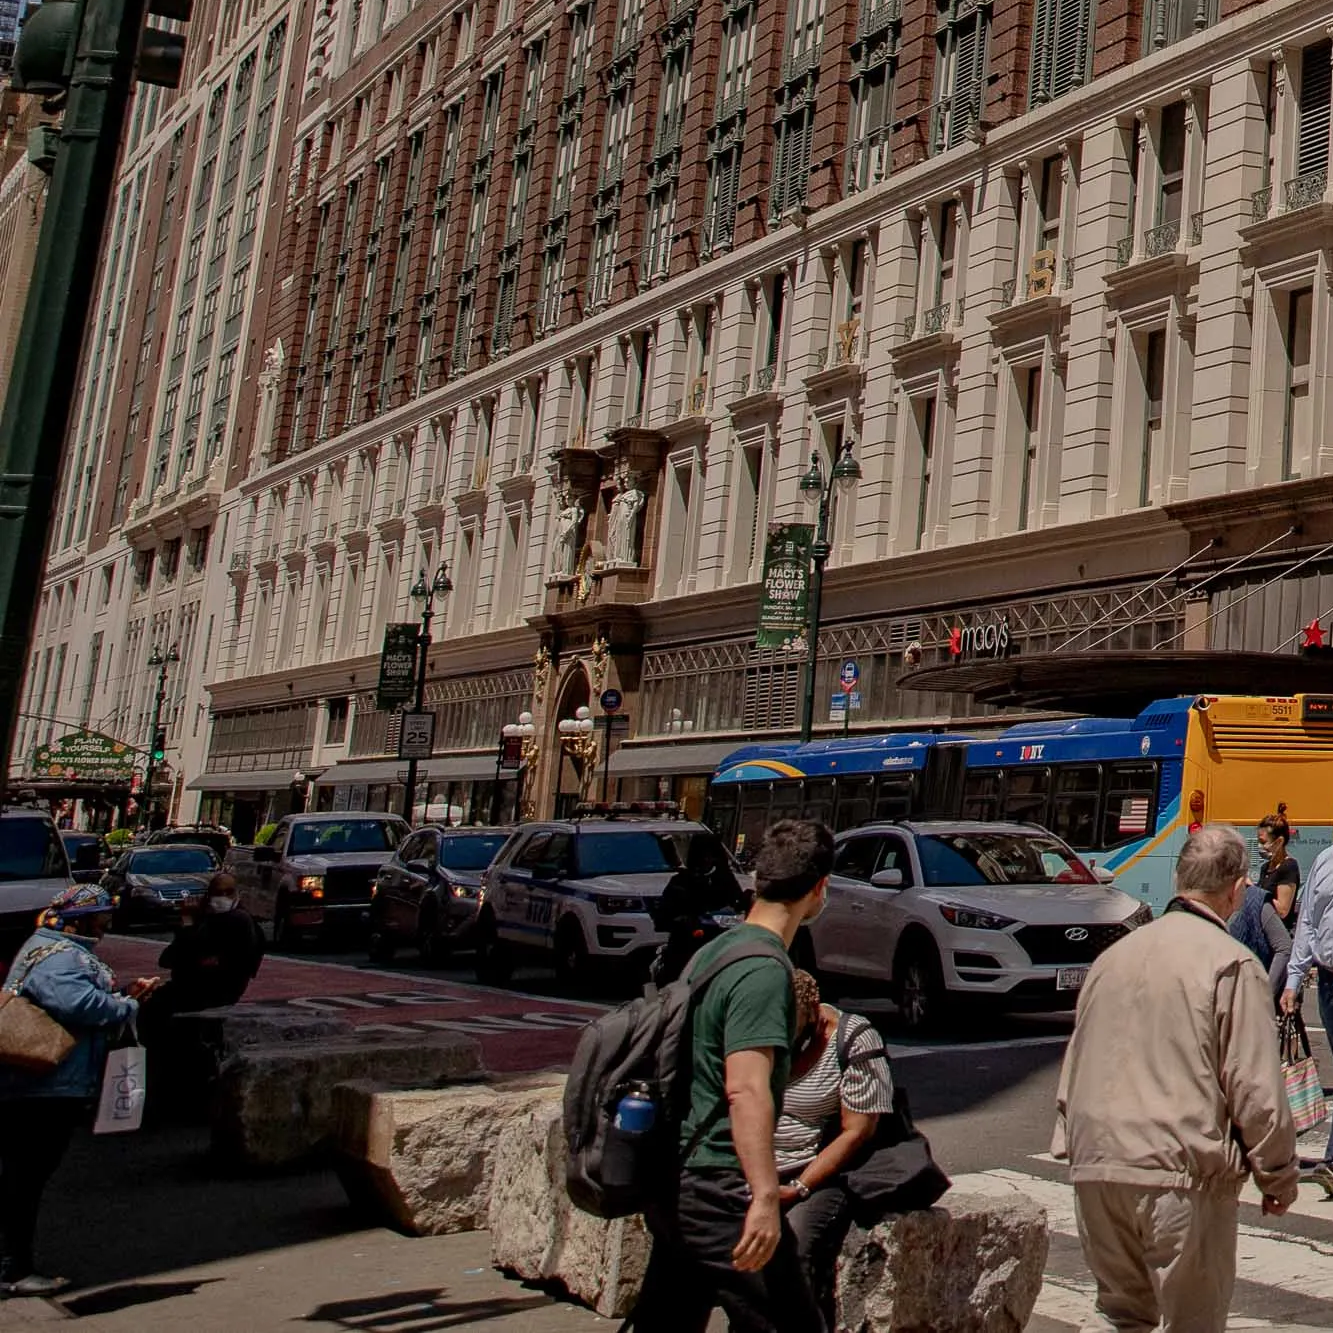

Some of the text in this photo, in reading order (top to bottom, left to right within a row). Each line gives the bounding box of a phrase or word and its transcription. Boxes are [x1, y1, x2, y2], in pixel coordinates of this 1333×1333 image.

[768, 568, 804, 579] MACY'S
[765, 579, 805, 590] FLOWER
[768, 589, 801, 600] SHOW
[961, 617, 1009, 659] macy's
[1272, 706, 1292, 715] 5511
[406, 731, 428, 744] 25
[65, 745, 111, 753] YOURSELF
[112, 1062, 139, 1121] rack
